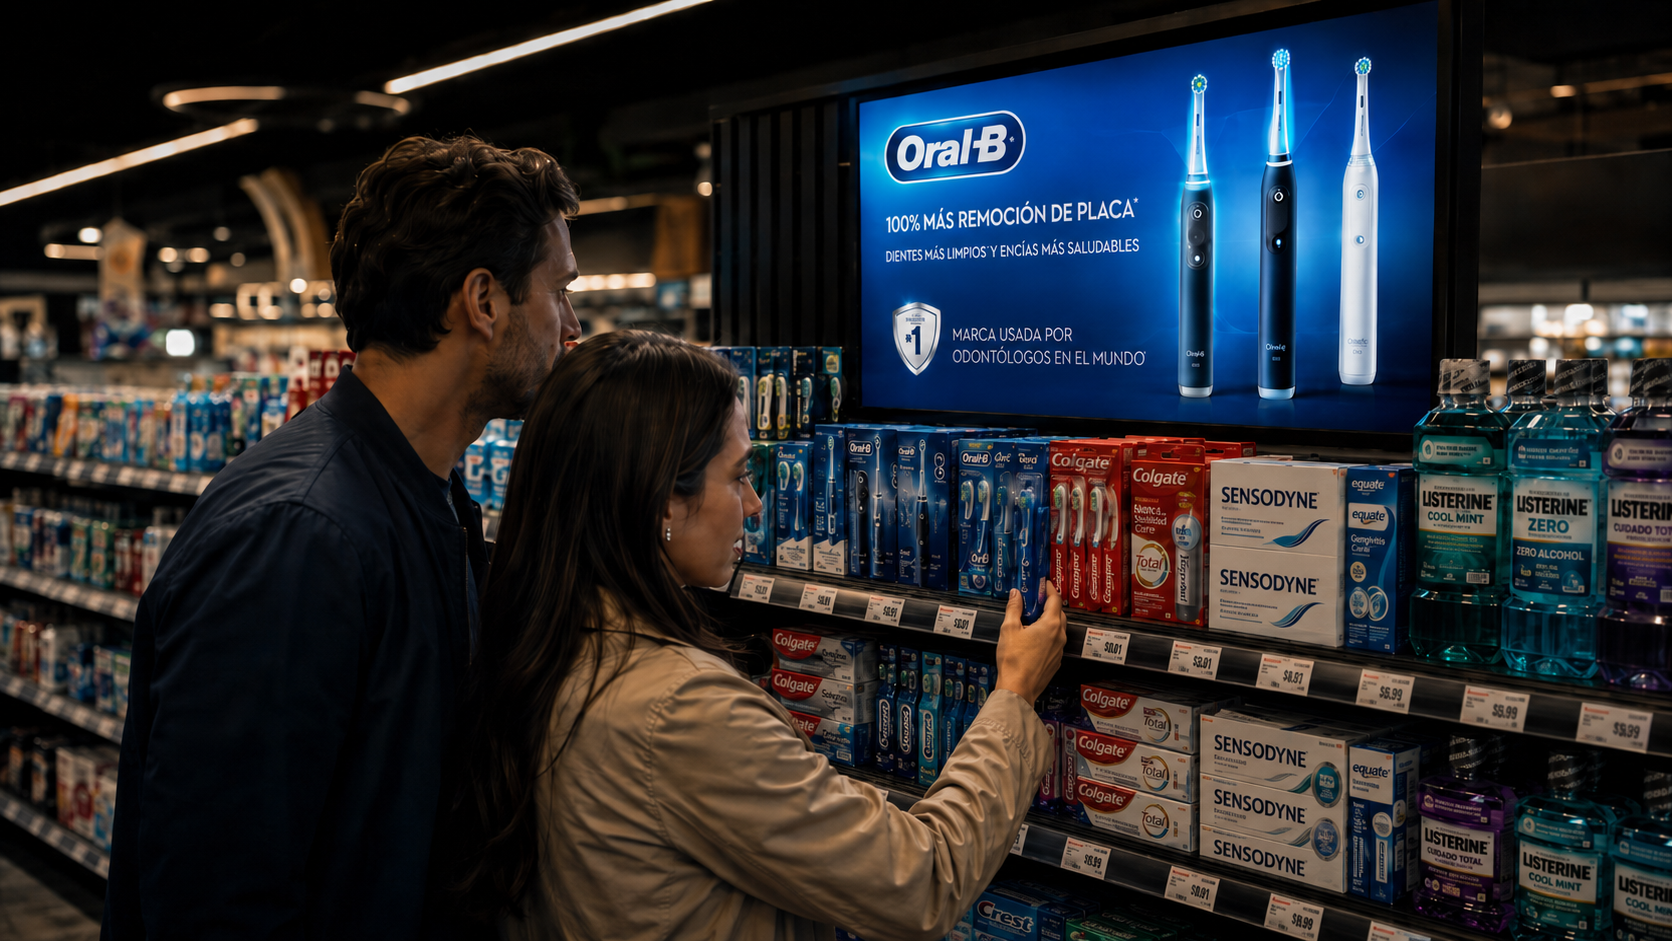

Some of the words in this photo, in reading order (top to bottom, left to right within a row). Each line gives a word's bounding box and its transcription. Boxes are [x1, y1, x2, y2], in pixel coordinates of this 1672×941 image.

[896, 124, 1008, 172] Oral-B
[886, 214, 921, 233] 100%
[923, 208, 954, 231] MÁS
[958, 201, 1047, 228] REMOCIÓN
[1051, 203, 1073, 223] DE
[886, 249, 923, 263] DIENTES
[925, 245, 945, 261] MÁS
[991, 245, 998, 258] Y
[1000, 241, 1038, 257] ENCÍAS
[1041, 239, 1065, 256] MÁS
[1067, 238, 1140, 255] SALUDABLES
[952, 328, 996, 342] MARCA
[1000, 327, 1041, 342] USADA
[1045, 327, 1073, 342] POR
[952, 346, 1051, 365] ODONTÓLOGOS
[1055, 350, 1071, 365] EN
[1075, 350, 1090, 365] EL
[1051, 453, 1110, 473] Colgate
[1133, 467, 1187, 487] Colgate
[1352, 479, 1384, 490] equate
[1221, 486, 1318, 509] SENSODYNE
[1422, 490, 1492, 510] LISTERINE
[1517, 495, 1588, 516] LISTERINE
[1352, 510, 1385, 523] equate
[1428, 511, 1454, 522] COOL
[1456, 512, 1484, 524] MINT
[1528, 518, 1569, 533] ZERO
[1136, 554, 1164, 570] Total
[1517, 546, 1537, 557] ZERO
[1538, 548, 1585, 561] ALCOHOL
[1220, 568, 1317, 595] SENSODYNE
[774, 632, 816, 651] Colgate
[773, 673, 816, 693] Colgate
[1082, 688, 1128, 709] Colgate
[1143, 715, 1167, 728] Total
[1078, 735, 1125, 758] Colgate
[1214, 734, 1307, 768] SENSODYNE
[1141, 763, 1165, 779] Total
[1353, 763, 1389, 778] equate
[1078, 783, 1124, 806] Colgate
[1214, 788, 1306, 824] SENSODYNE
[1141, 811, 1165, 826] Total
[1425, 828, 1488, 855] LISTERINE
[1213, 839, 1305, 876] SENSODYNE
[1459, 854, 1483, 866] TOTAL
[1523, 852, 1591, 880] LISTERINE
[1529, 872, 1554, 887] COOL
[1556, 878, 1582, 892] MINT
[1626, 896, 1652, 912] COOL
[977, 900, 1035, 933] Crest
